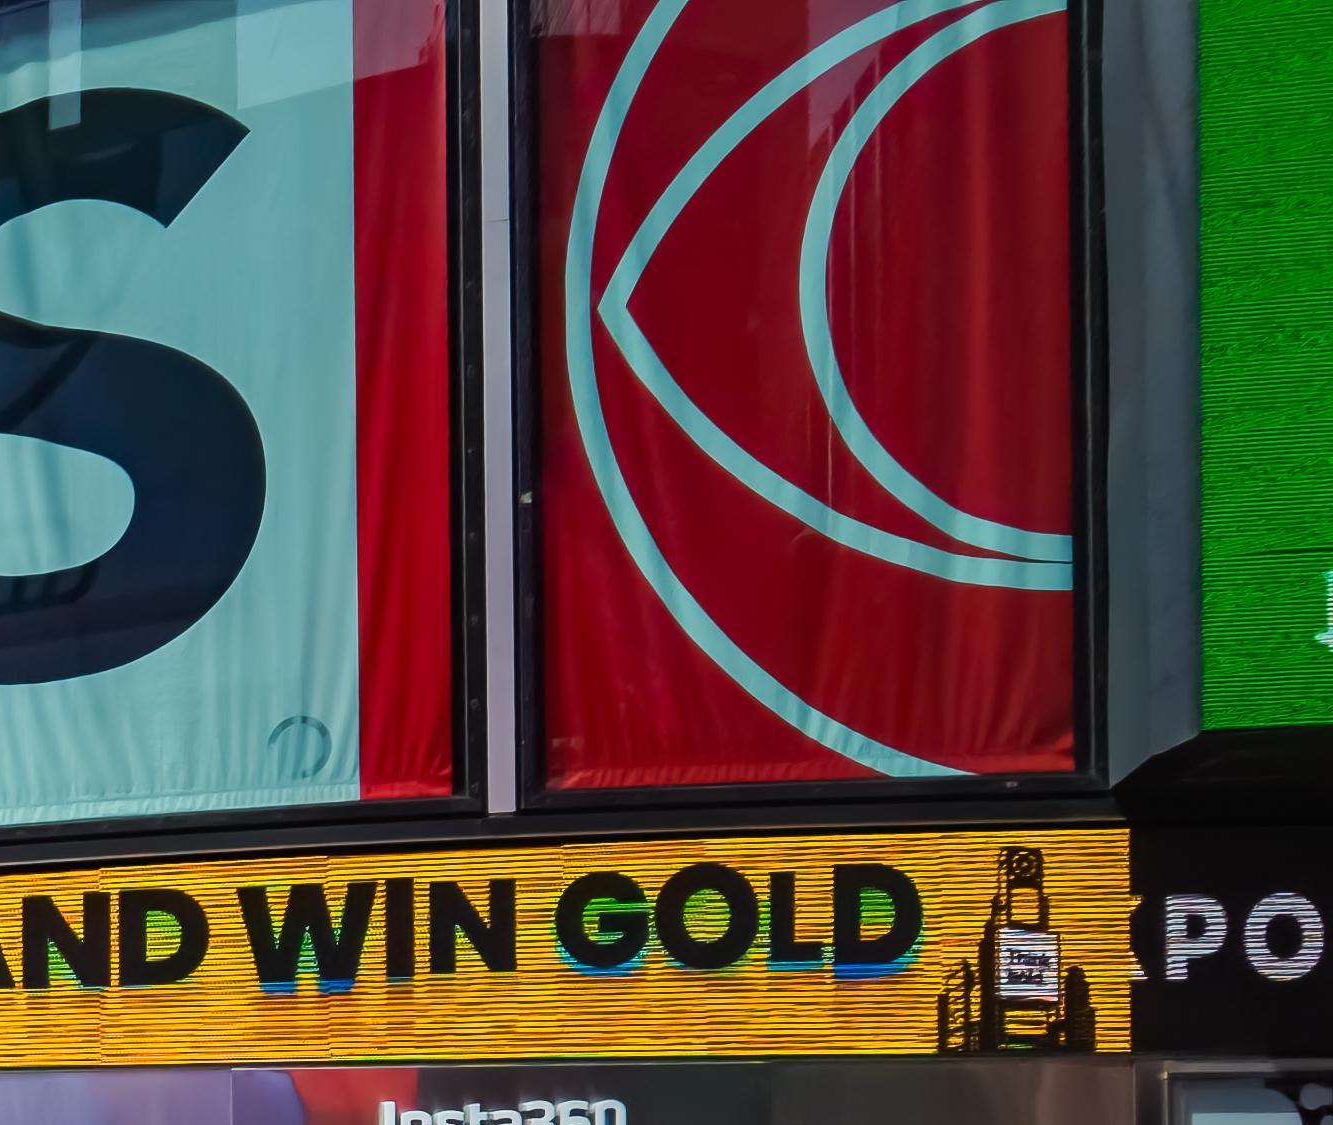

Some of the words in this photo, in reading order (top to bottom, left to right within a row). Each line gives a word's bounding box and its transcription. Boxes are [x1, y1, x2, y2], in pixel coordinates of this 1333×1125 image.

[237, 877, 517, 992] WIN
[554, 862, 925, 978] GOLD
[1133, 893, 1325, 981] PO
